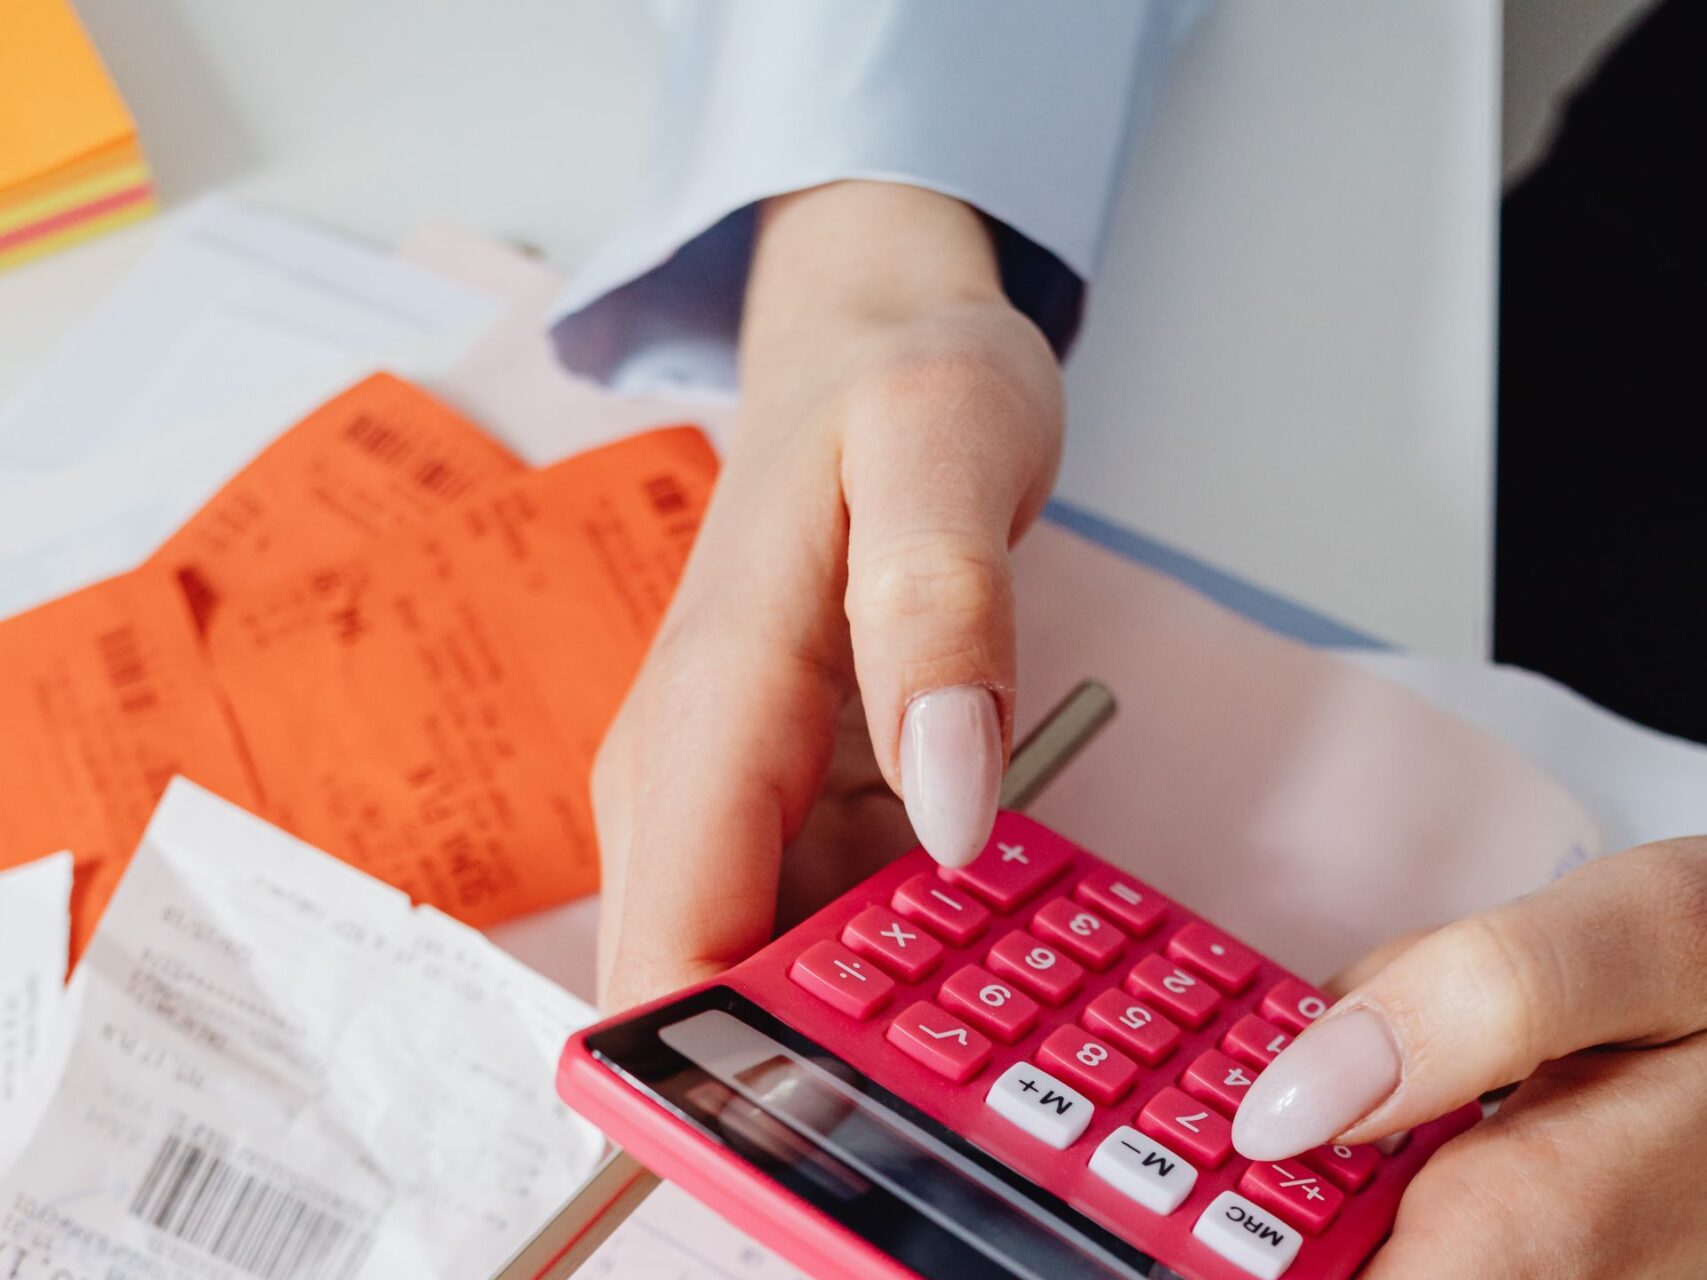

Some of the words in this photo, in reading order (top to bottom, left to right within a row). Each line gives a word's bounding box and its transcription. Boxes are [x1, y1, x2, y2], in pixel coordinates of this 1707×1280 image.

[1070, 913, 1100, 936] 3
[1025, 947, 1057, 969] 6
[1163, 969, 1195, 993] 2
[979, 984, 1011, 1006] 9
[1120, 1006, 1152, 1029] 5
[1298, 997, 1326, 1018] 0
[1268, 1034, 1285, 1051] 1
[1076, 1042, 1107, 1066] 8
[1223, 1068, 1251, 1086] 4
[1019, 1079, 1072, 1115] M+
[1176, 1111, 1207, 1133] 7
[1225, 1205, 1284, 1246] MRC
